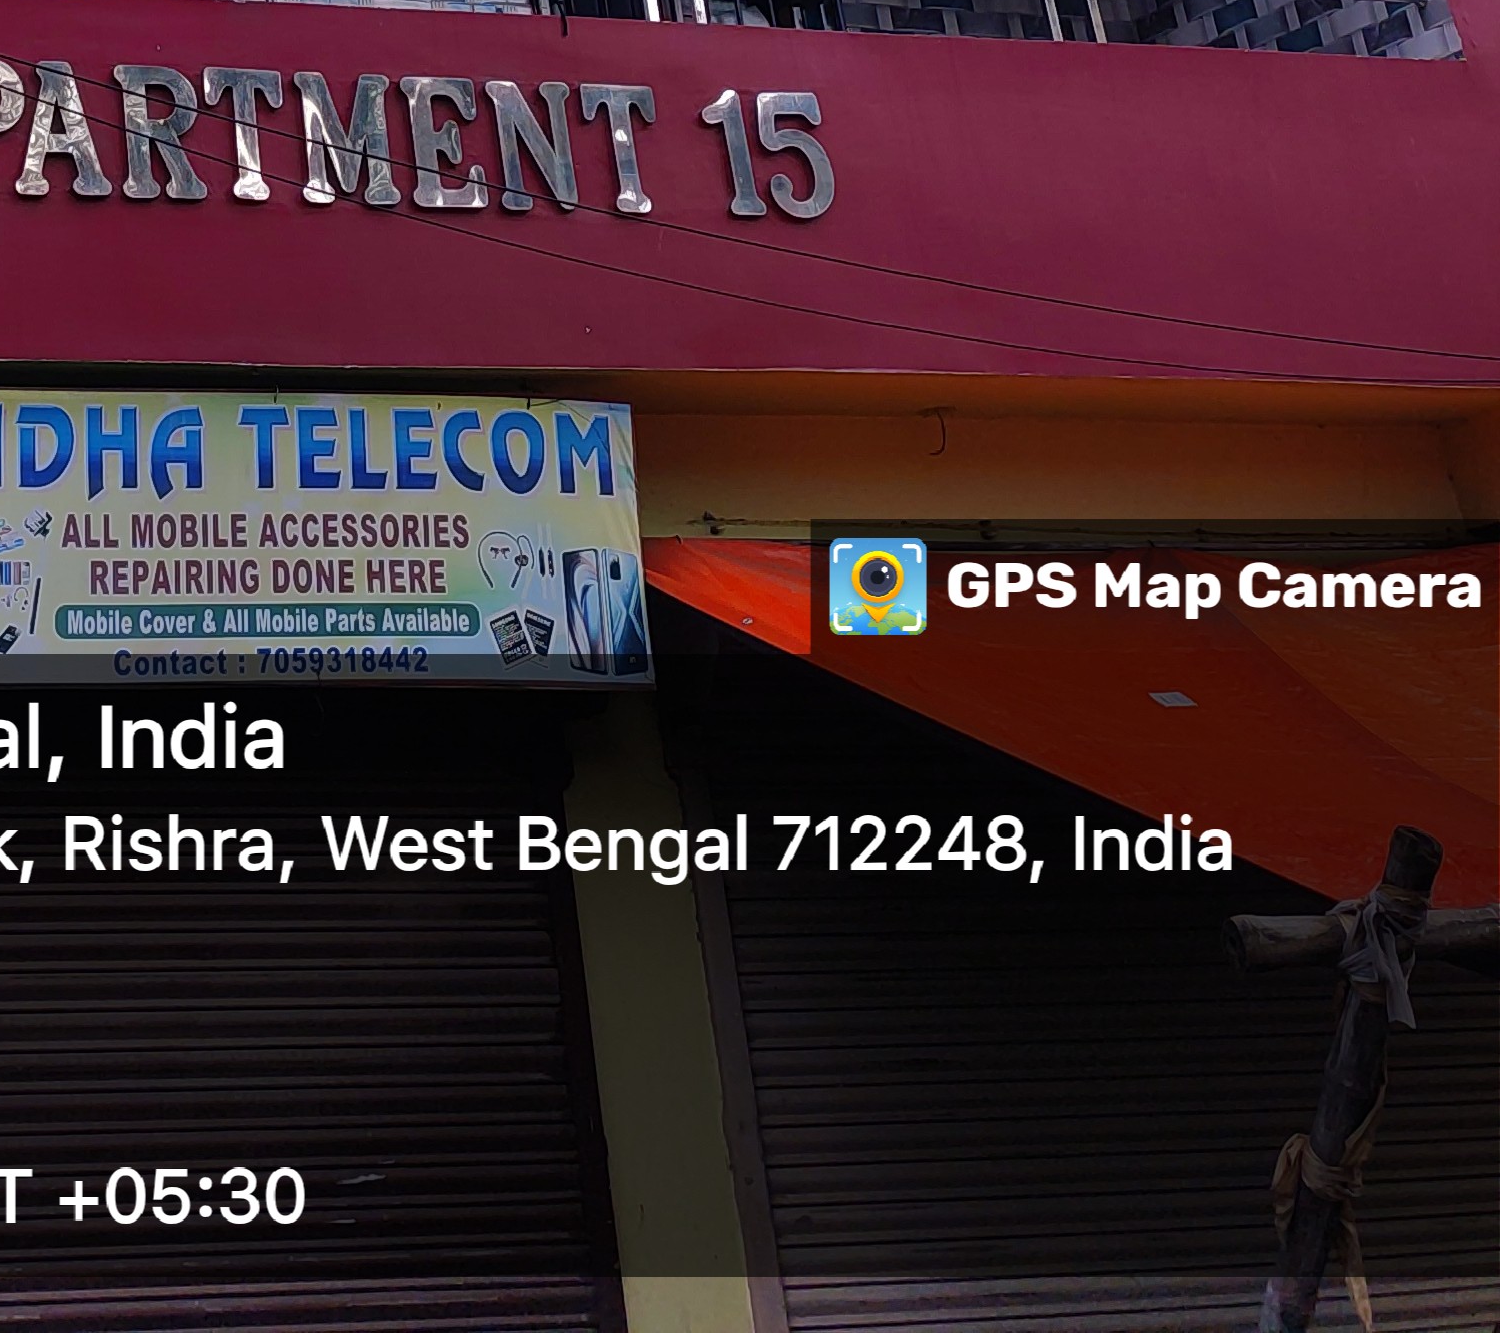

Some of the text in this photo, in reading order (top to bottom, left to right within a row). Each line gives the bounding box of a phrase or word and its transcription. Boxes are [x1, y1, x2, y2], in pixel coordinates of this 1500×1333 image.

[702, 90, 836, 219] 15
[238, 406, 614, 496] TELECOM
[62, 514, 469, 548] ALL MOBILE ACCESSORIES
[90, 559, 447, 595] REPAIRING DONE HERE
[67, 609, 133, 634] Mobile
[139, 610, 196, 634] Cover
[202, 608, 217, 633] &
[224, 608, 249, 633] All
[255, 608, 318, 633] Mobile
[325, 608, 376, 632] Parts
[382, 608, 470, 632] Available
[114, 649, 227, 675] Contact
[257, 647, 429, 674] 7059318442
